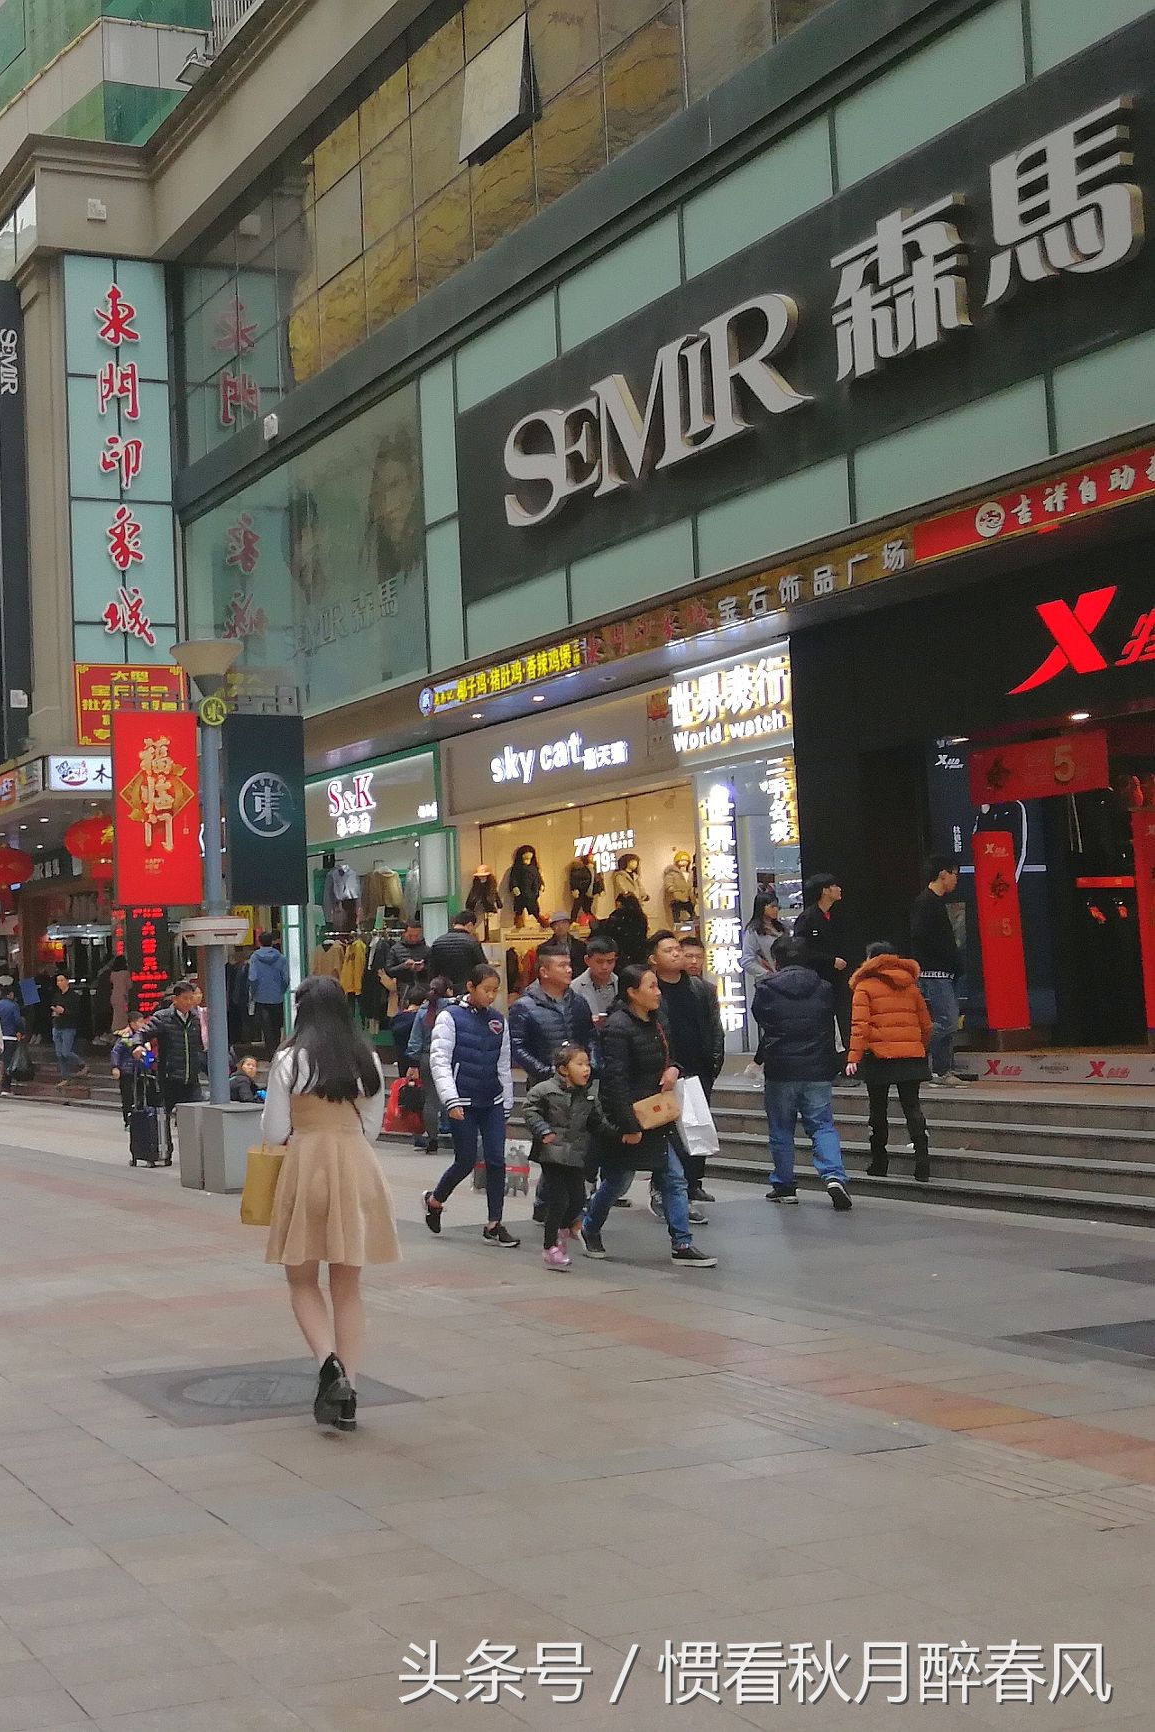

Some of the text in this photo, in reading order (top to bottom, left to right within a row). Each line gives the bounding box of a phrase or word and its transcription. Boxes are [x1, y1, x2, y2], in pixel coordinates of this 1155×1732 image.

[503, 292, 815, 526] SEMIR
[829, 95, 1144, 382] 森馬
[0, 328, 19, 396] SEMIR
[96, 284, 156, 646] 東門印象城
[716, 539, 906, 625] 宝石饰品广场
[1004, 585, 1118, 695] X
[490, 744, 535, 784] sky
[539, 731, 582, 771] cat
[673, 722, 723, 752] World
[328, 772, 376, 817] S&K
